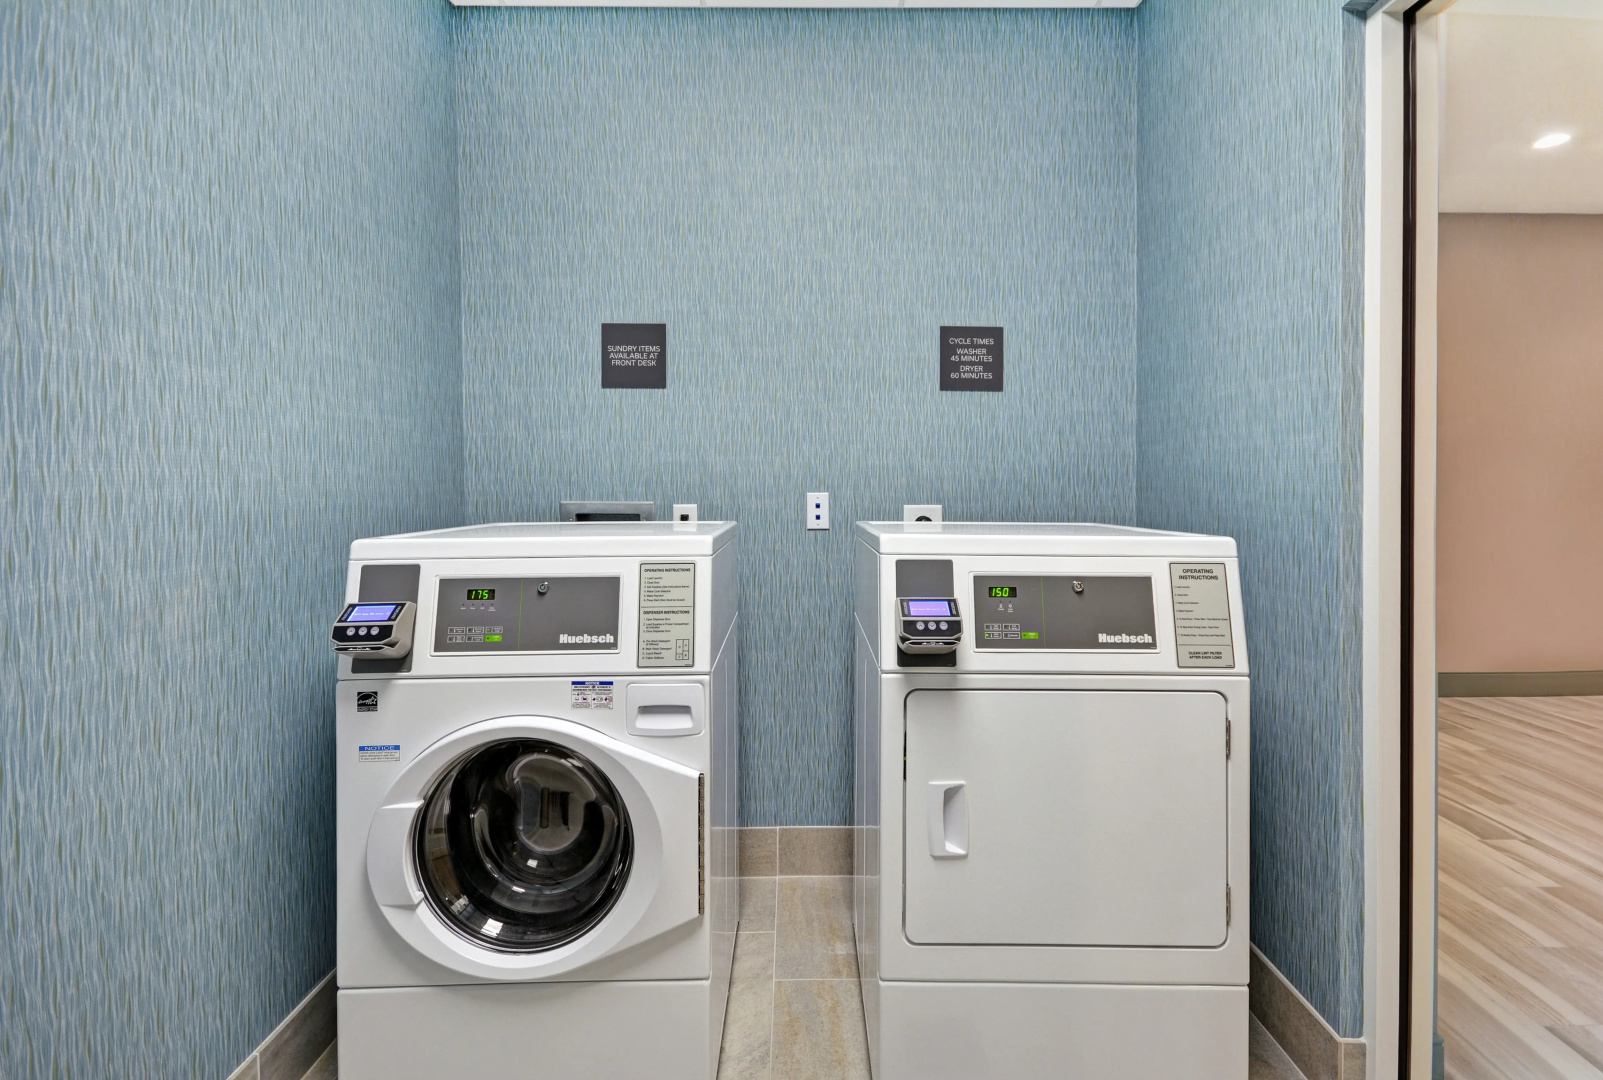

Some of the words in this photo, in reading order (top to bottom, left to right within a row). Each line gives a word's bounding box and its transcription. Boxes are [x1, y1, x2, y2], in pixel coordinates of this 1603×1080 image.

[471, 590, 489, 600] 175
[992, 588, 1009, 597] 150
[559, 633, 614, 644] Huebsch
[1098, 633, 1153, 643] Huebsch
